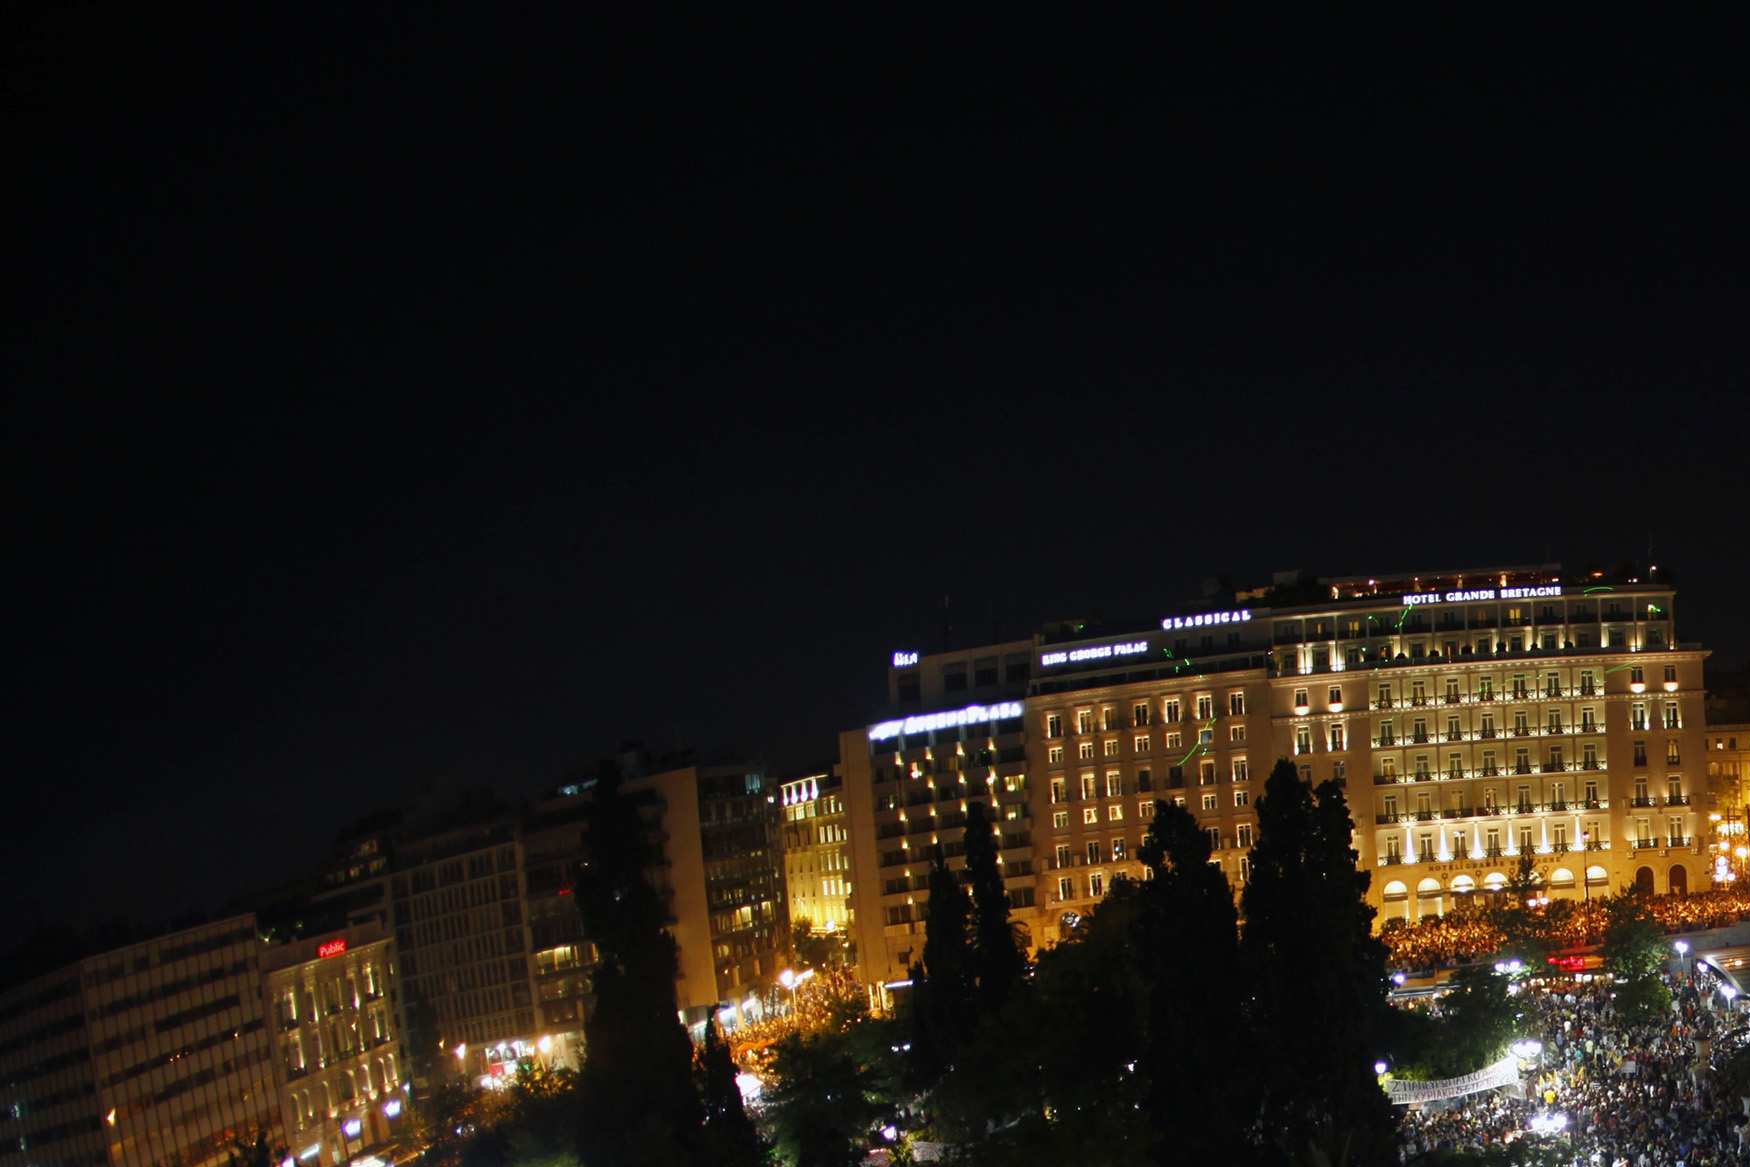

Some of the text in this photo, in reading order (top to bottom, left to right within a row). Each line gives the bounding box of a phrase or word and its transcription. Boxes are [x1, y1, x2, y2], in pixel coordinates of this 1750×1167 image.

[1402, 586, 1561, 605] HOTEL GRANDE BRETAGNE
[1162, 610, 1250, 630] CLASSICAL
[1042, 650, 1067, 666] KING
[1069, 646, 1112, 661] GEORGE
